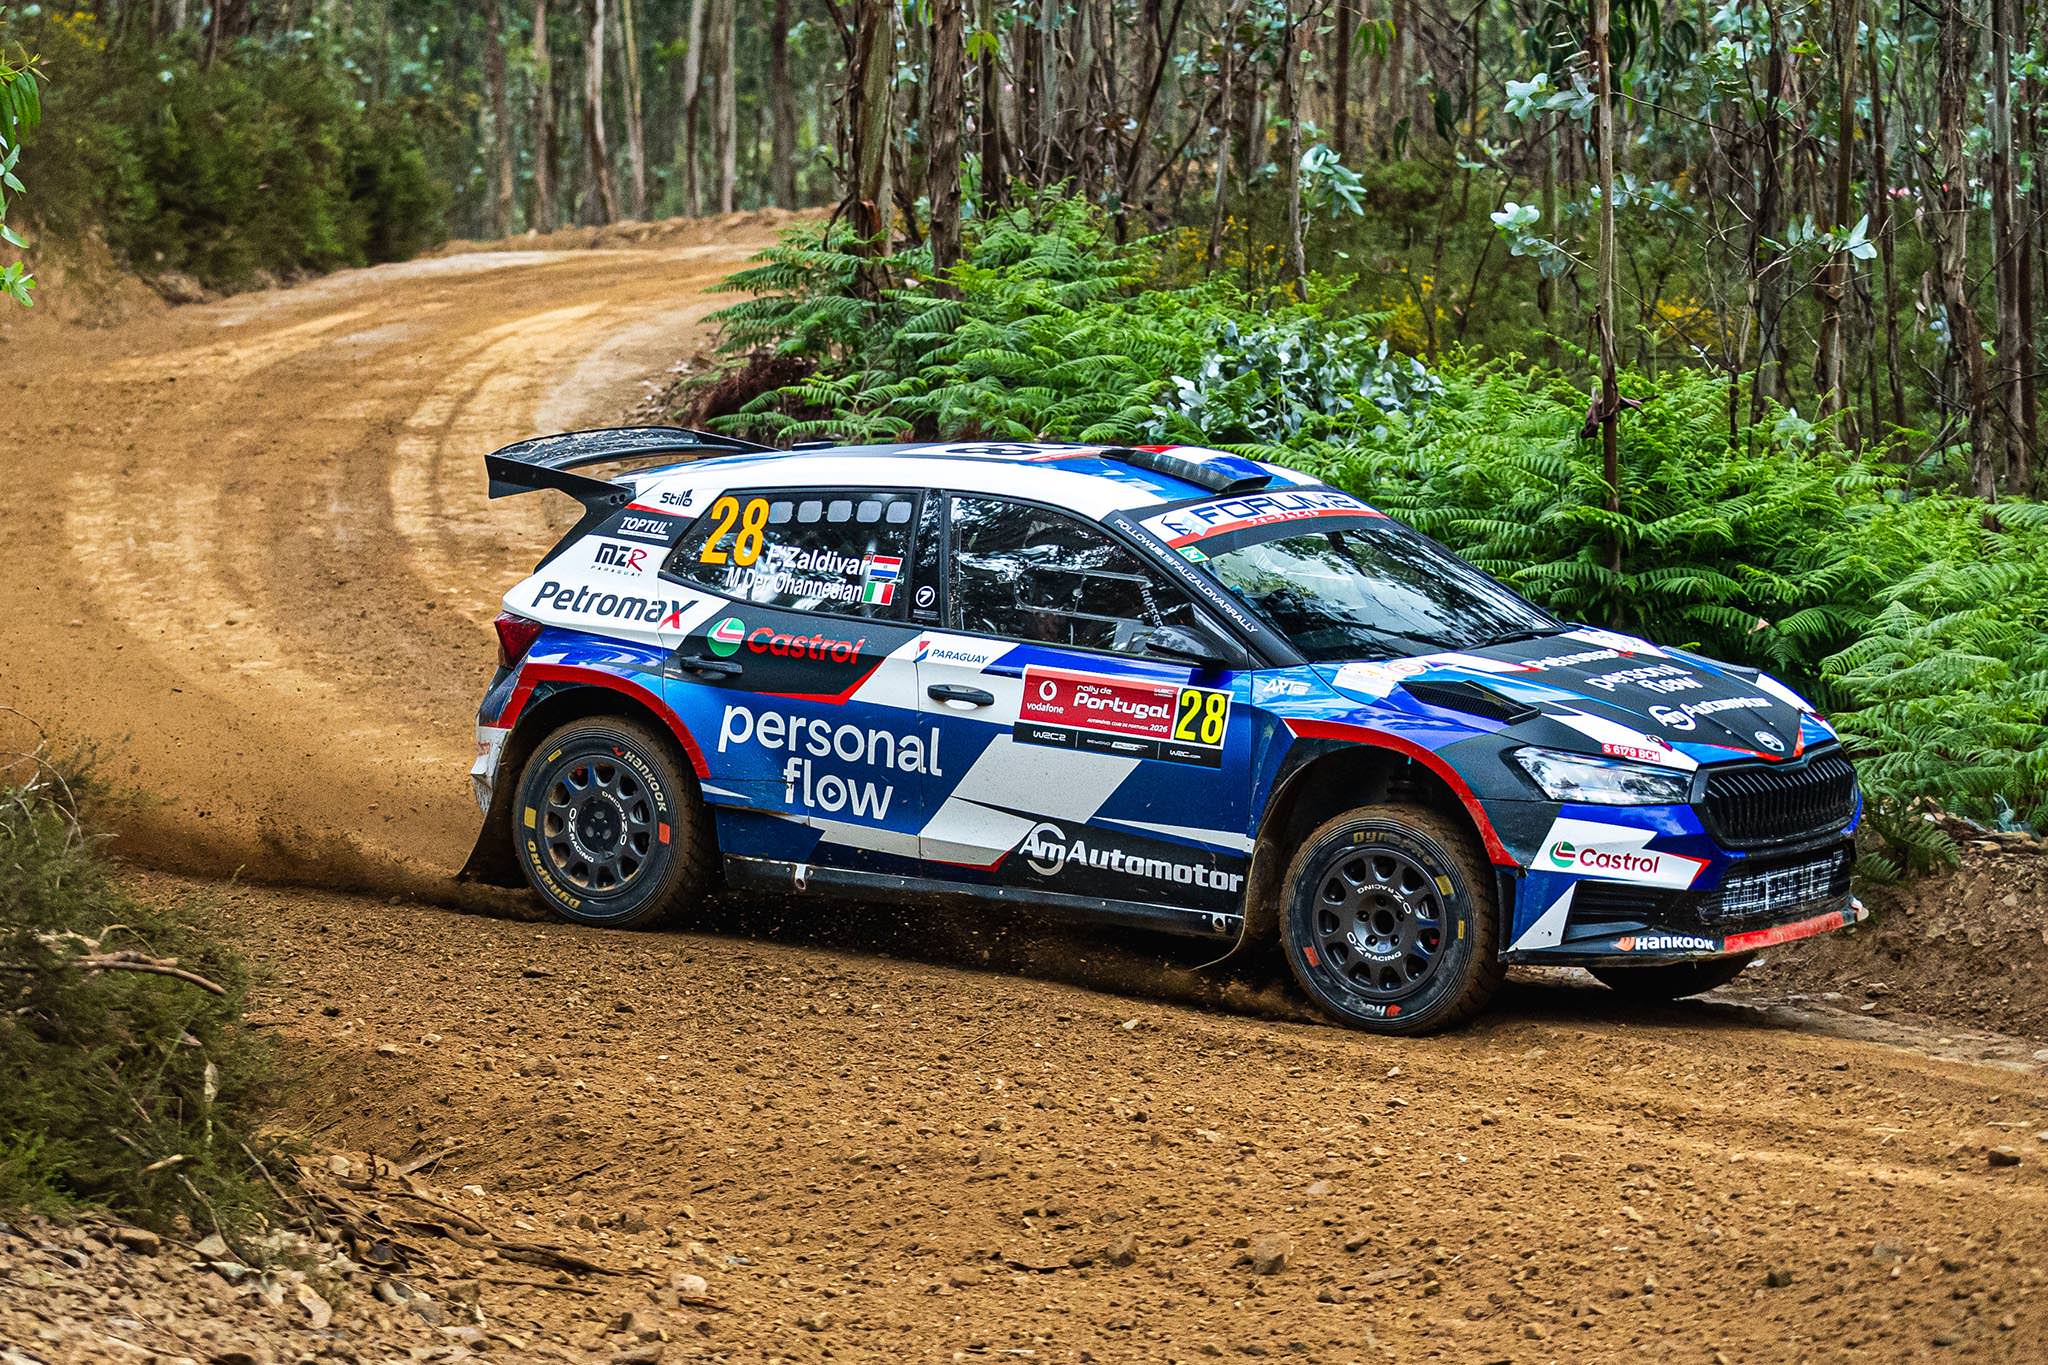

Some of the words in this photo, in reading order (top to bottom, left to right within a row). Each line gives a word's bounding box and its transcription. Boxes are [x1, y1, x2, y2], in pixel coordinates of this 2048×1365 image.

[659, 489, 693, 507] Stilo
[620, 517, 667, 534] TOPTUL
[700, 496, 770, 567] 28
[1114, 519, 1152, 547] FOLLOW
[766, 543, 871, 576] F.Zaldivar
[531, 581, 699, 629] Petromax
[746, 627, 865, 664] Castrol
[931, 649, 988, 664] PARAGUAY
[1077, 685, 1099, 695] rally
[1100, 686, 1112, 695] de
[1026, 702, 1064, 714] vodafone
[1073, 692, 1171, 719] Portugal
[1175, 690, 1226, 744] 28
[717, 704, 943, 777] personal
[1149, 723, 1169, 733] 2026
[1603, 744, 1611, 753] S
[1612, 745, 1637, 757] 6179
[1638, 749, 1660, 761] BCM
[624, 751, 667, 812] Hankook
[783, 757, 894, 820] flow
[569, 833, 594, 863] RACING
[1579, 848, 1660, 873] Castrol
[1065, 841, 1244, 892] Automotor
[1356, 884, 1395, 894] RACING
[1364, 951, 1402, 962] RACING
[1635, 937, 1715, 950] Hankook
